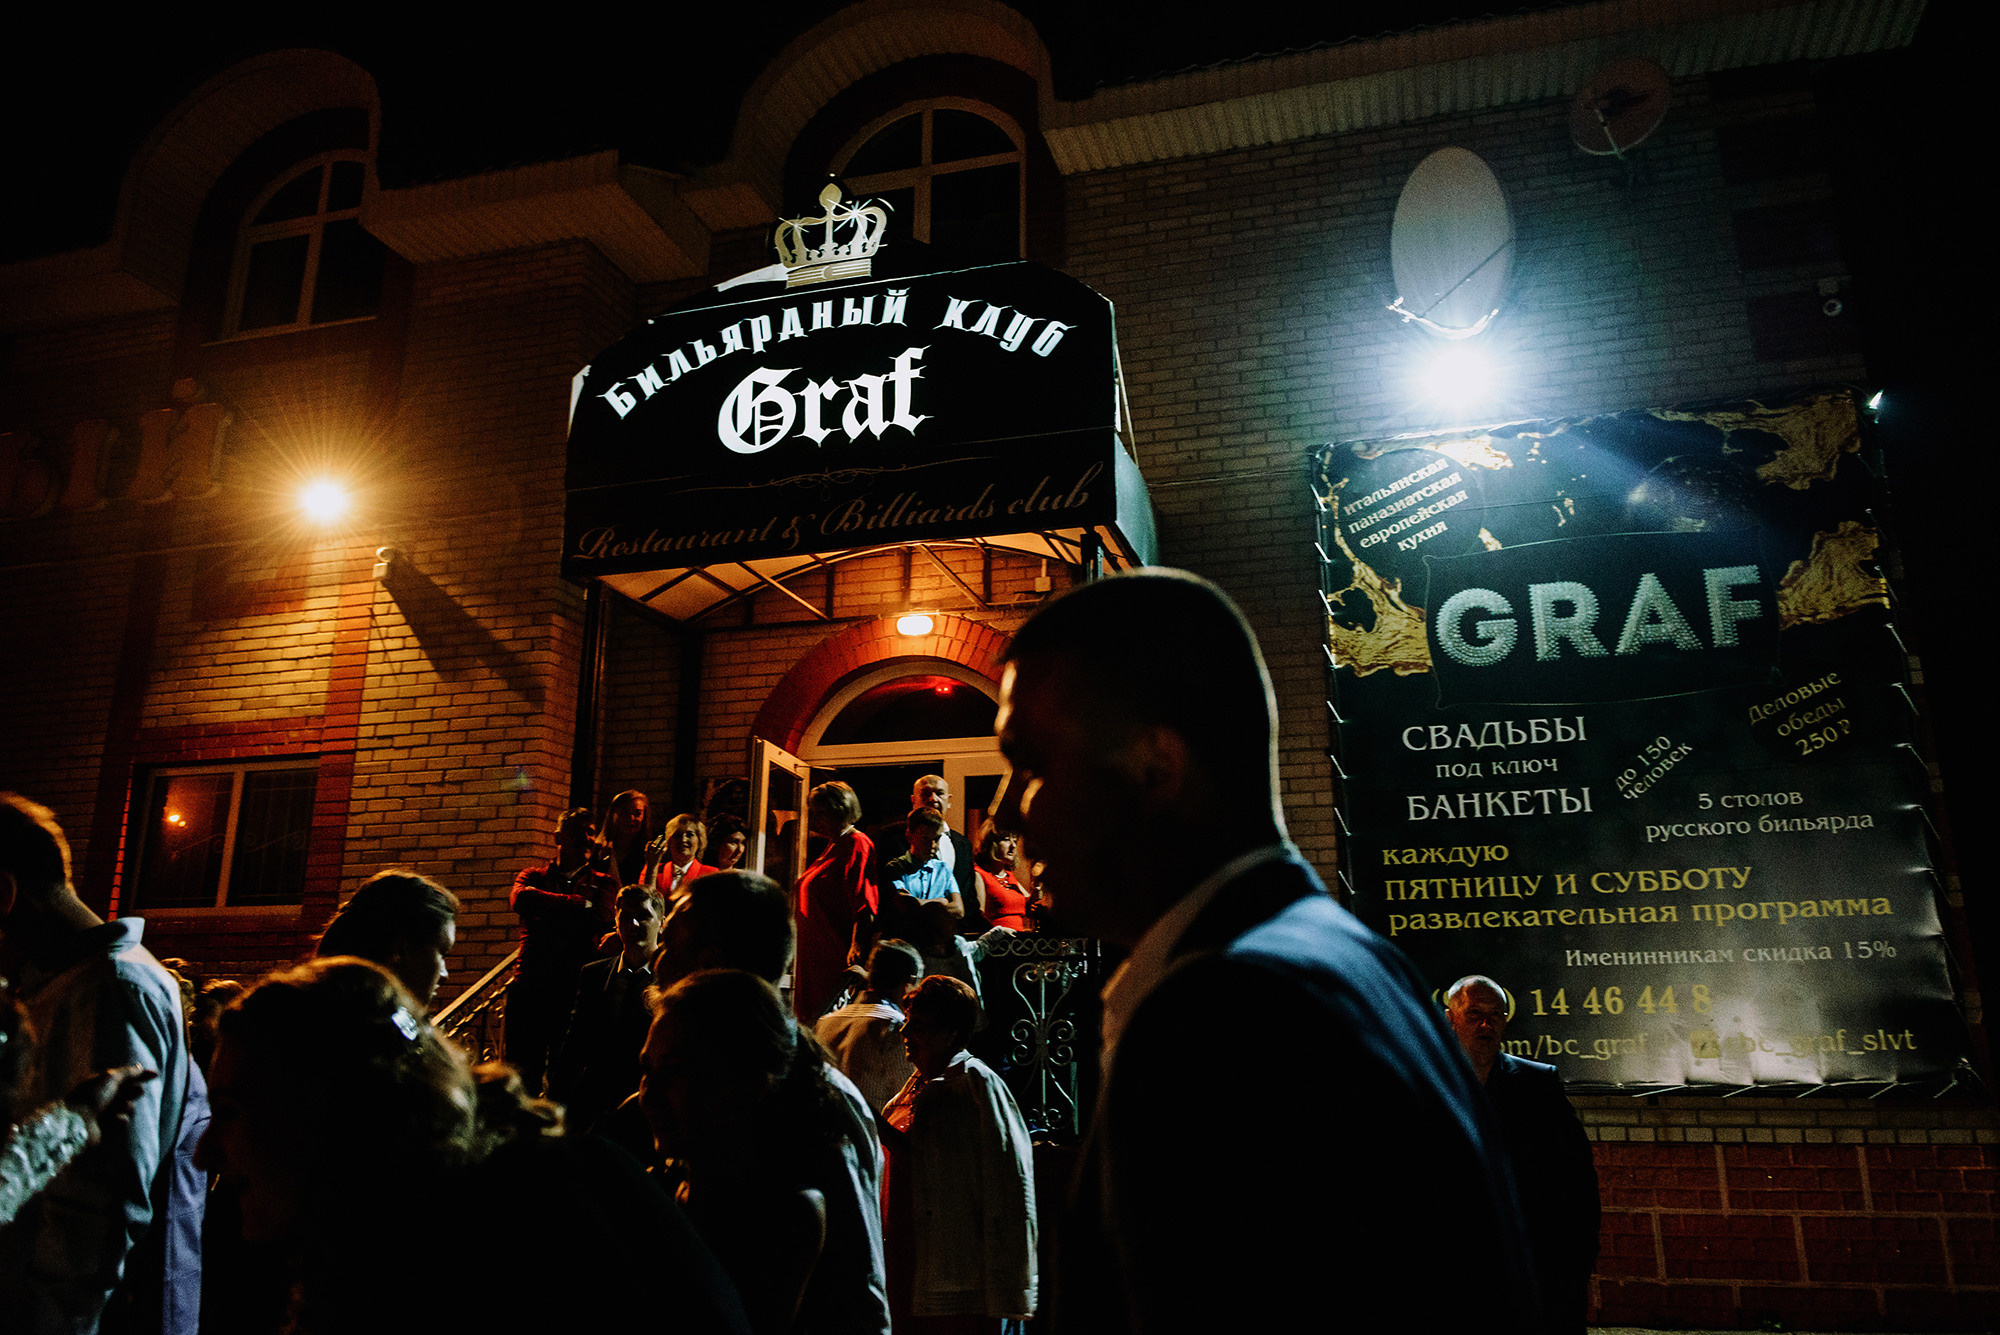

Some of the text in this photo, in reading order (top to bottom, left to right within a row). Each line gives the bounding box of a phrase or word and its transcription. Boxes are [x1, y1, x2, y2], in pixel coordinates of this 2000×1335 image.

[933, 295, 1079, 358] клуб
[717, 344, 935, 454] Graf
[1343, 458, 1450, 516] итальянская
[1348, 471, 1463, 534] паназиатская
[571, 515, 780, 560] Restaurant
[820, 482, 1001, 535] Billiards
[1006, 461, 1104, 515] club
[1359, 489, 1470, 548] европейская
[1396, 520, 1449, 552] кухня
[1435, 564, 1763, 667] GRAF
[1748, 671, 1842, 725] Деловые
[1776, 697, 1847, 737] обеды
[1401, 715, 1588, 751] СВАДЬБЫ
[1794, 726, 1839, 756] 250
[1436, 758, 1559, 780] под ключ
[1614, 735, 1672, 792] до 150
[1622, 742, 1694, 801] человек
[1406, 786, 1594, 821] БАНКЕТЫ
[1698, 791, 1805, 810] 5 столов
[1645, 813, 1875, 843] русского бильярда
[1382, 844, 1510, 868] каждую
[1384, 866, 1752, 901] ПЯТНИЦУ И СУББОТУ
[1389, 897, 1894, 937] развлекательная программа
[1565, 941, 1898, 967] Именинникам скидка 15%
[1530, 987, 1571, 1017] 14
[1582, 986, 1625, 1016] 46
[1636, 985, 1679, 1015] 44
[1691, 984, 1713, 1015] 8
